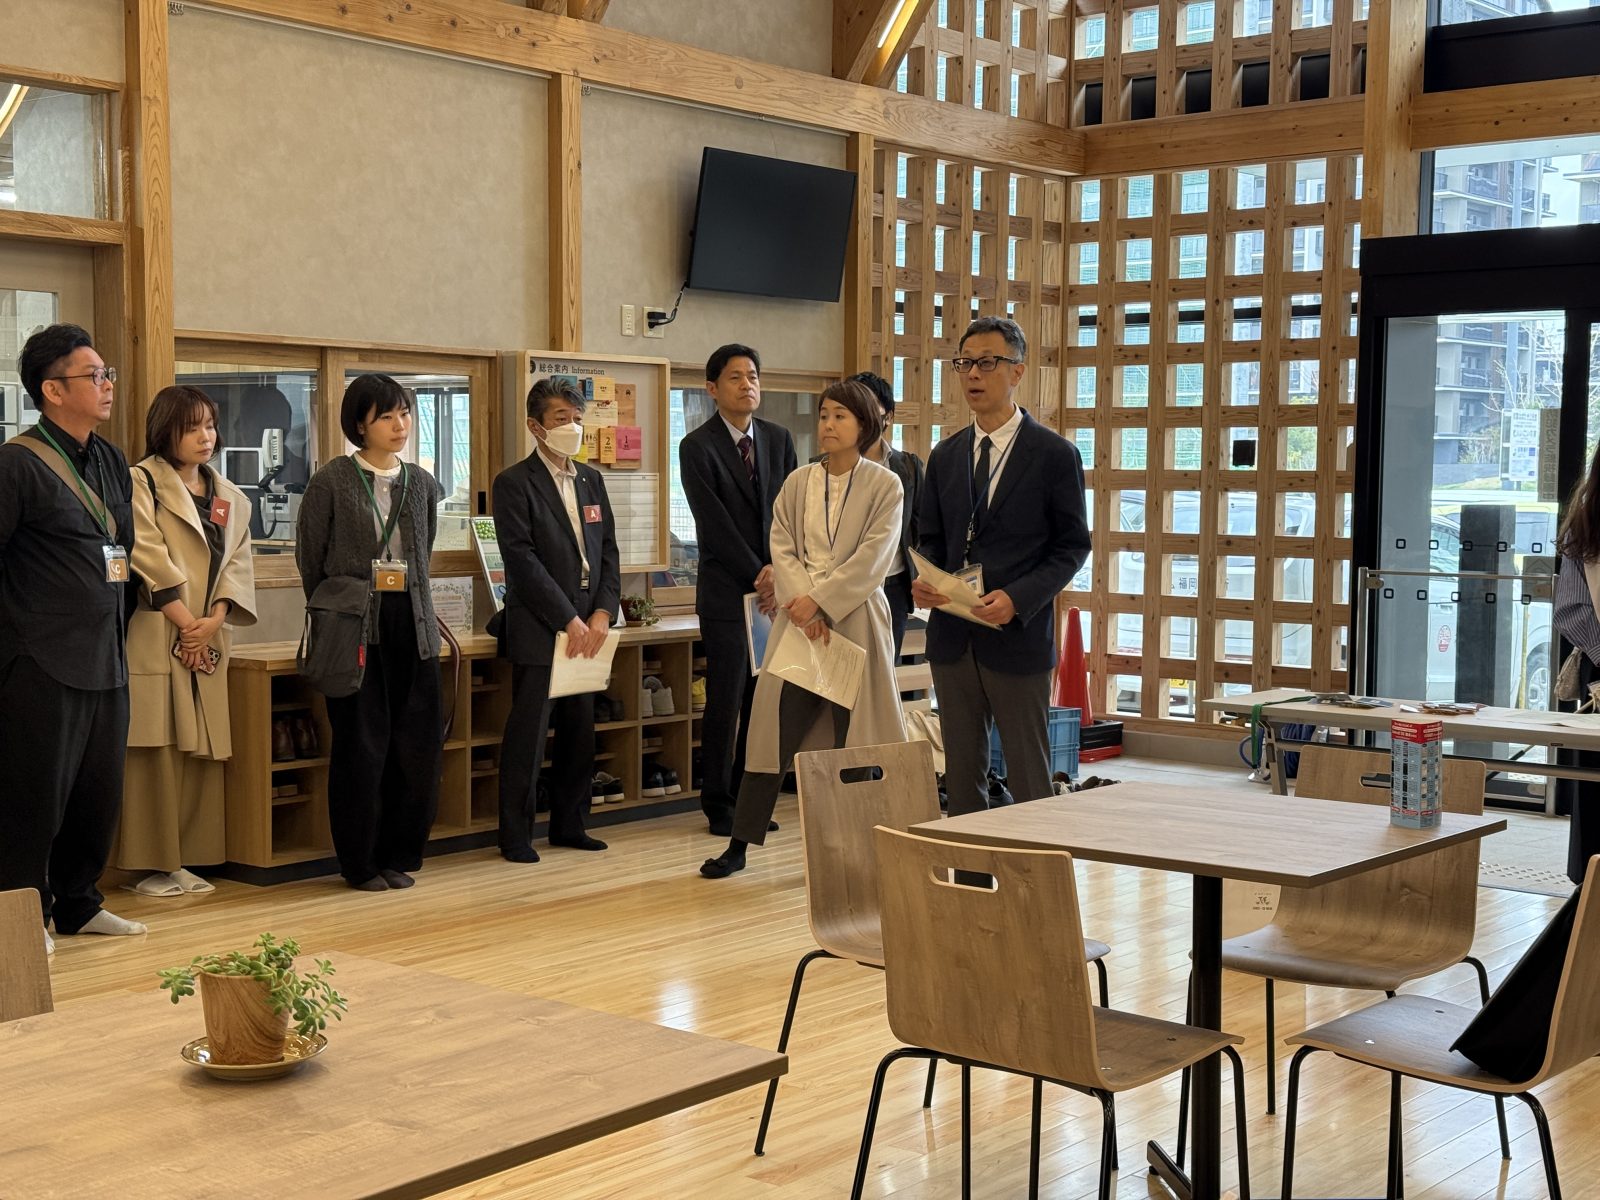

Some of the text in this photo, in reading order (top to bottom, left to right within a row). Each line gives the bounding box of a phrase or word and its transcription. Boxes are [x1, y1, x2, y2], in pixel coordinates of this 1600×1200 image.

[539, 362, 605, 375] 総合案内 Information
[605, 437, 611, 446] 2
[216, 508, 225, 517] A
[590, 509, 596, 518] A
[115, 564, 121, 574] C
[386, 575, 395, 585] C
[1179, 577, 1197, 589] 福岡
